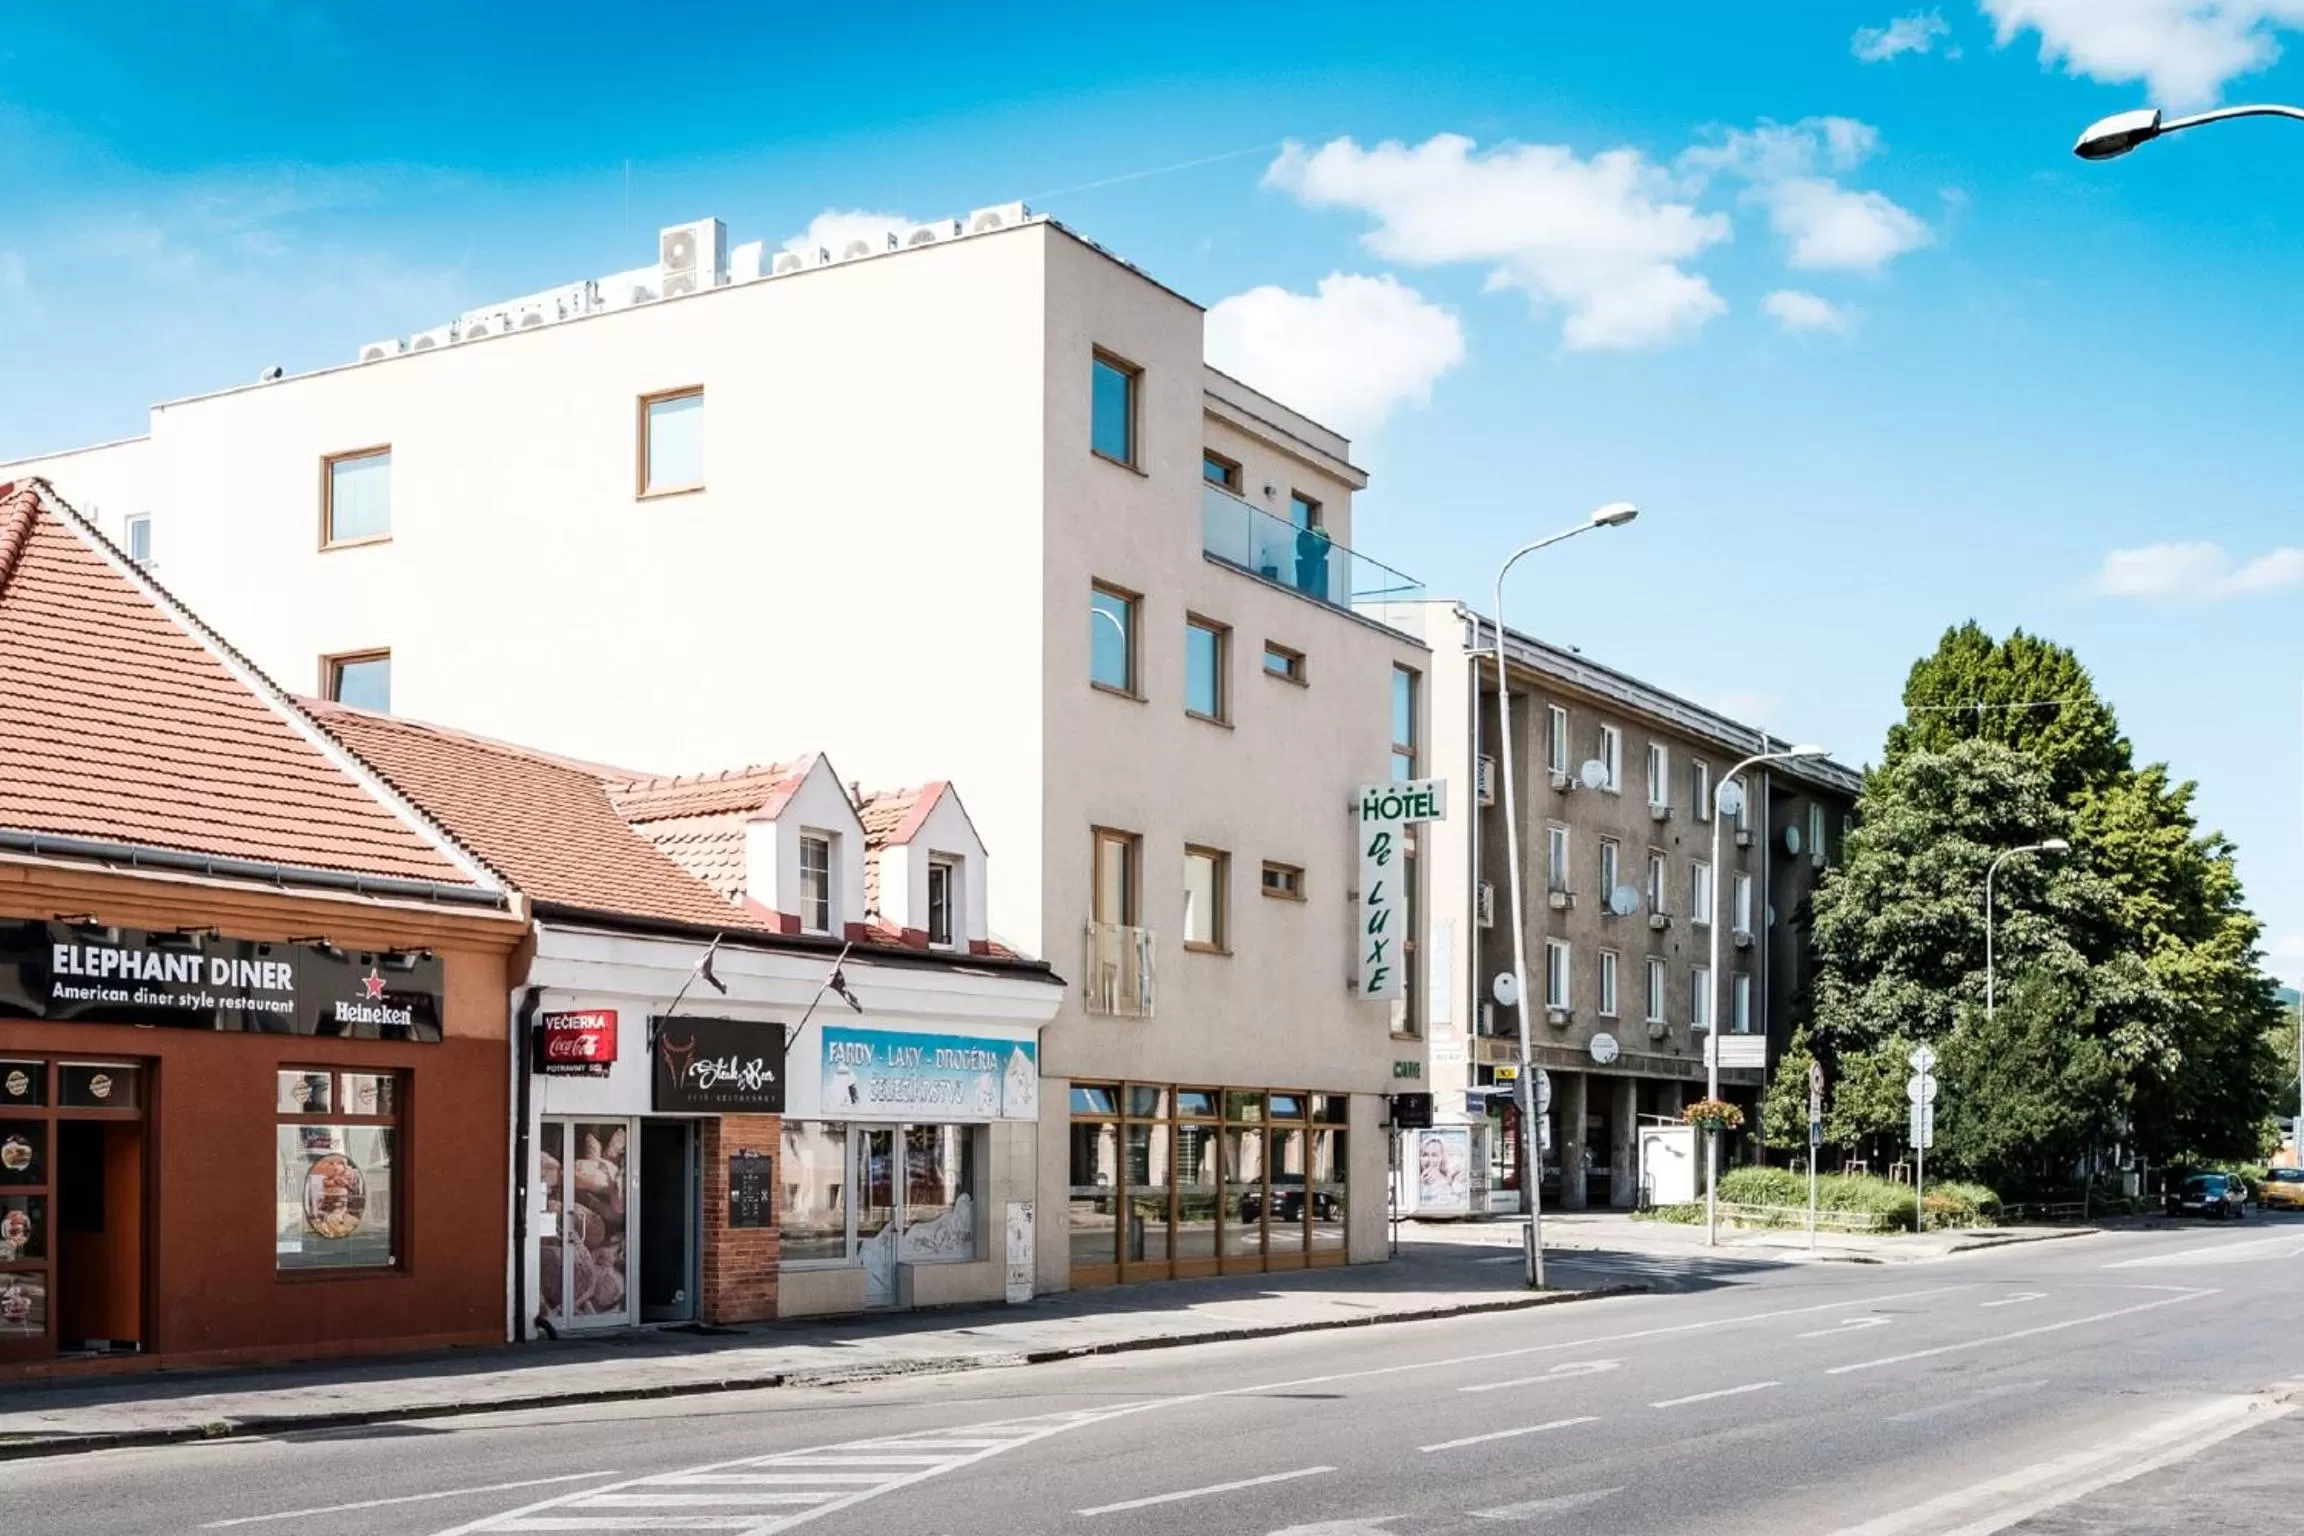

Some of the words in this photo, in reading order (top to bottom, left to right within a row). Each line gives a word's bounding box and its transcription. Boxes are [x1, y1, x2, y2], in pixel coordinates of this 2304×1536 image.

[1363, 792, 1439, 821] HOTEL
[1367, 832, 1391, 866] De
[1367, 880, 1391, 993] LUXE
[52, 944, 203, 984] ELEPHANT
[210, 957, 294, 990] DINER
[52, 981, 129, 1002] American
[133, 986, 173, 1006] diner
[179, 991, 215, 1011] style
[219, 997, 294, 1014] restaurant
[335, 1001, 411, 1025] Heineken
[546, 1014, 606, 1030] VEČIERKA
[688, 1056, 738, 1090] Steak
[888, 1046, 924, 1068] LAKY
